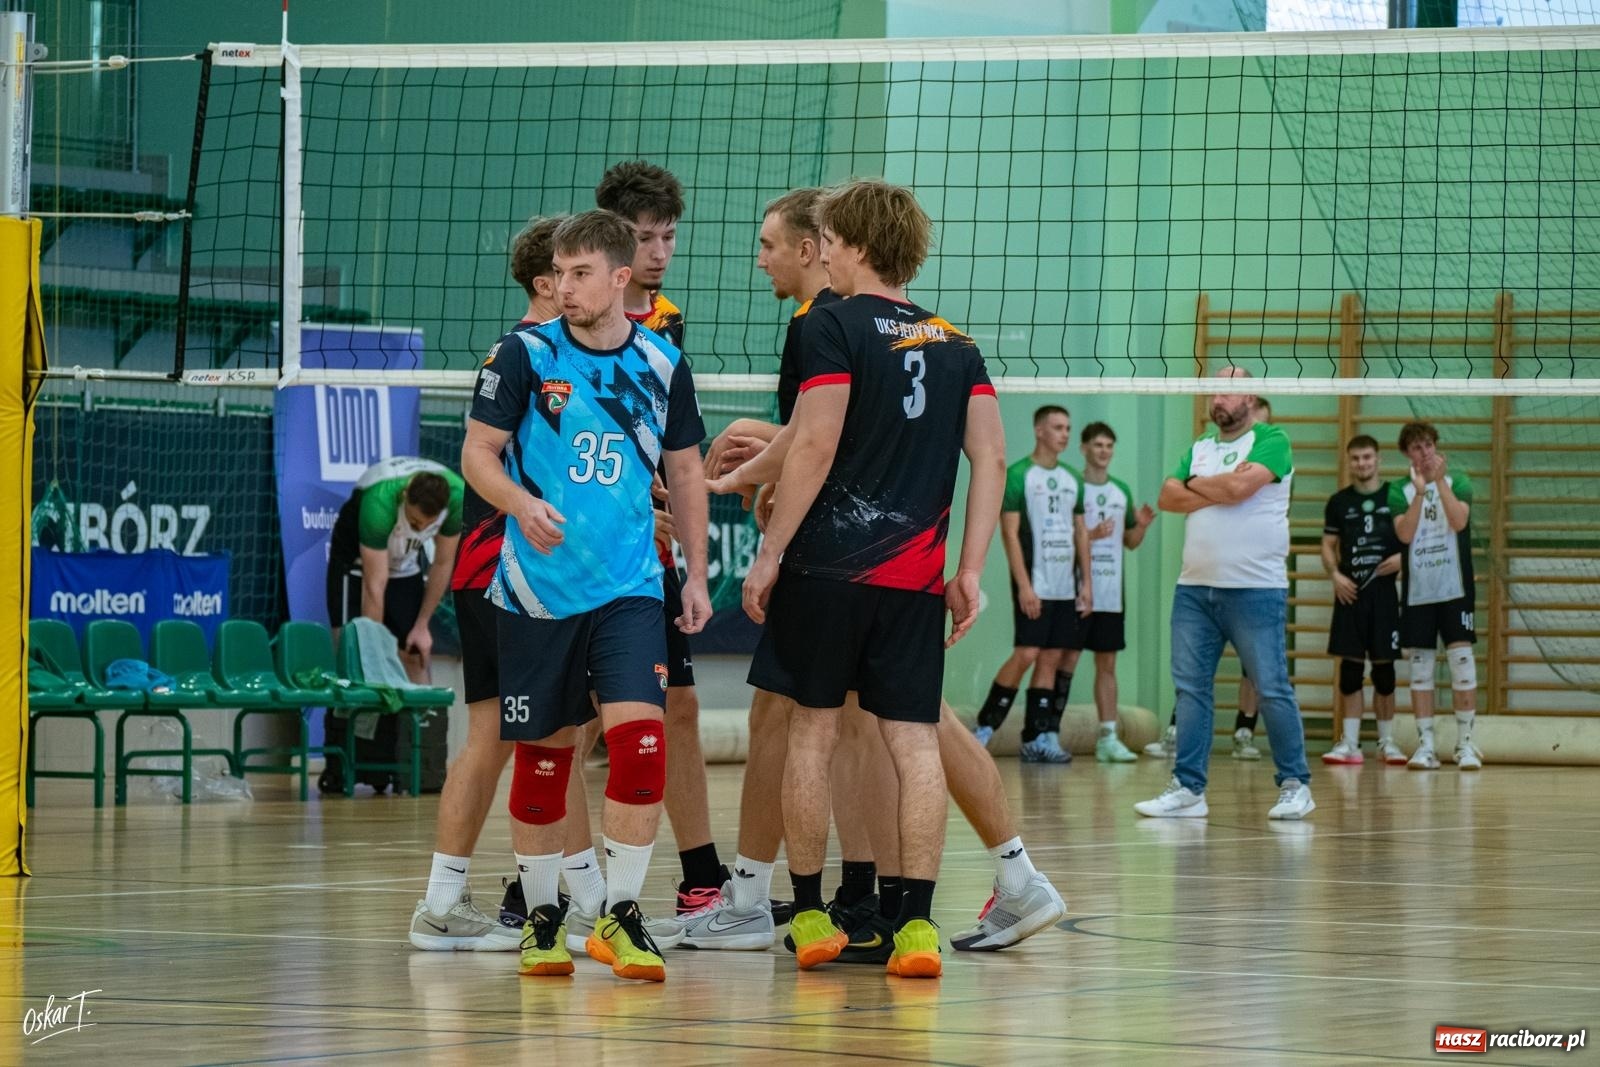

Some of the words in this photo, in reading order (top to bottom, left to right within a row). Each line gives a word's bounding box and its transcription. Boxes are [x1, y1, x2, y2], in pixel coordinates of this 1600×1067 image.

[221, 49, 251, 58] netex
[874, 317, 899, 336] UKS
[191, 374, 221, 382] netex
[903, 350, 926, 419] 3
[568, 431, 625, 485] 35
[50, 589, 146, 615] molten
[173, 590, 222, 616] molten
[504, 696, 530, 723] 35
